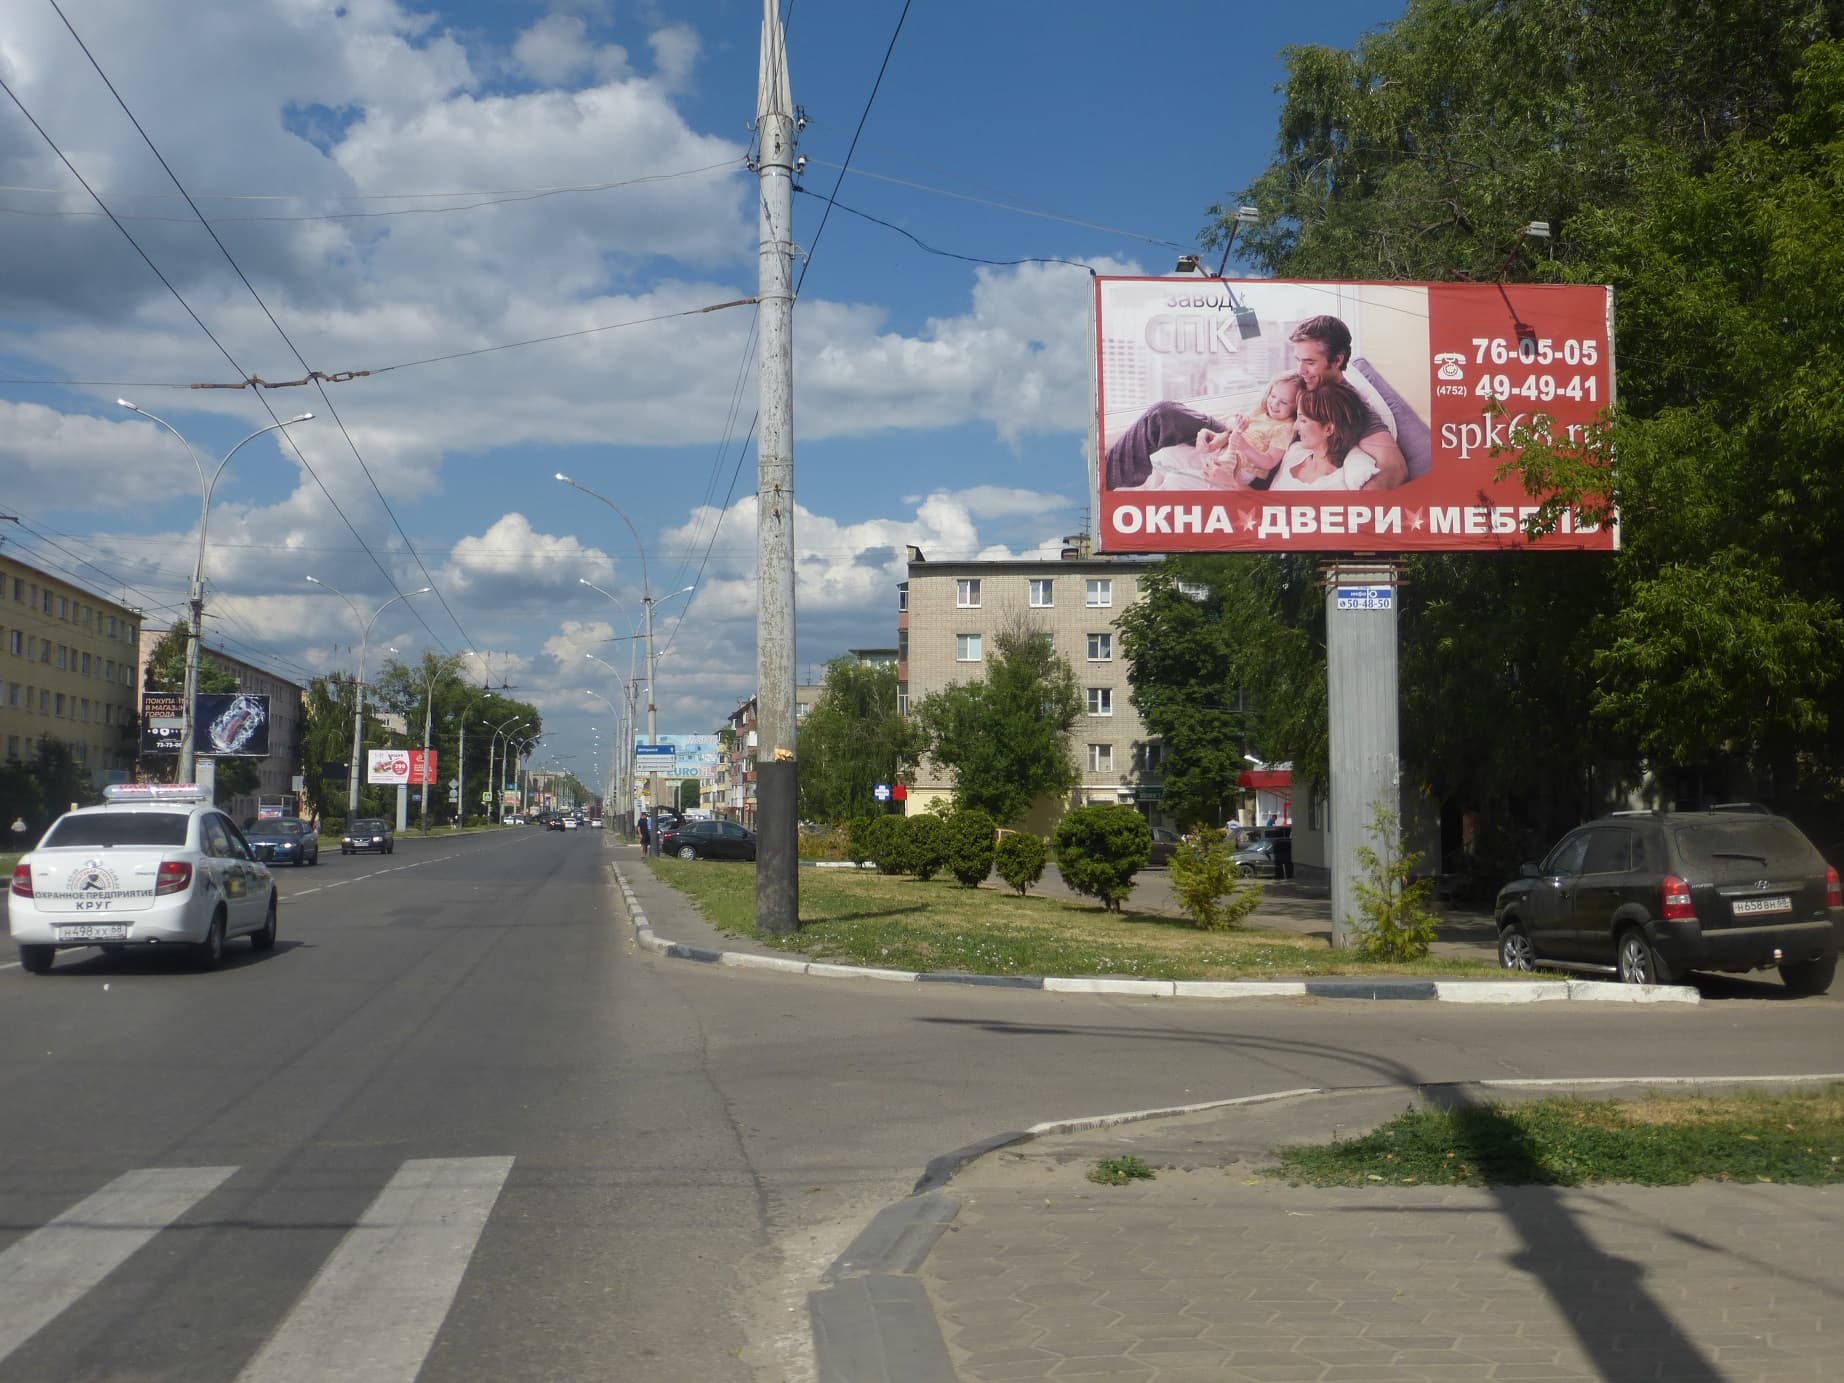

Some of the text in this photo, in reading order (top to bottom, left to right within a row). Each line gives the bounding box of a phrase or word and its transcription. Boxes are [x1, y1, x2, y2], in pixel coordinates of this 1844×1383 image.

[1167, 295, 1234, 312] завод
[1145, 314, 1240, 353] СПК
[1472, 338, 1598, 366] 76-05-05
[1436, 385, 1467, 397] (4752)
[1475, 374, 1597, 402] 49-49-41
[1112, 505, 1233, 534] ОКНА
[1258, 506, 1402, 539] ДВЕРИ
[1347, 599, 1390, 608] 50-48-50
[35, 889, 153, 899] ОХРАННОЕ ПРЕДПРИЯТИЕ
[76, 901, 111, 910] КРУГ
